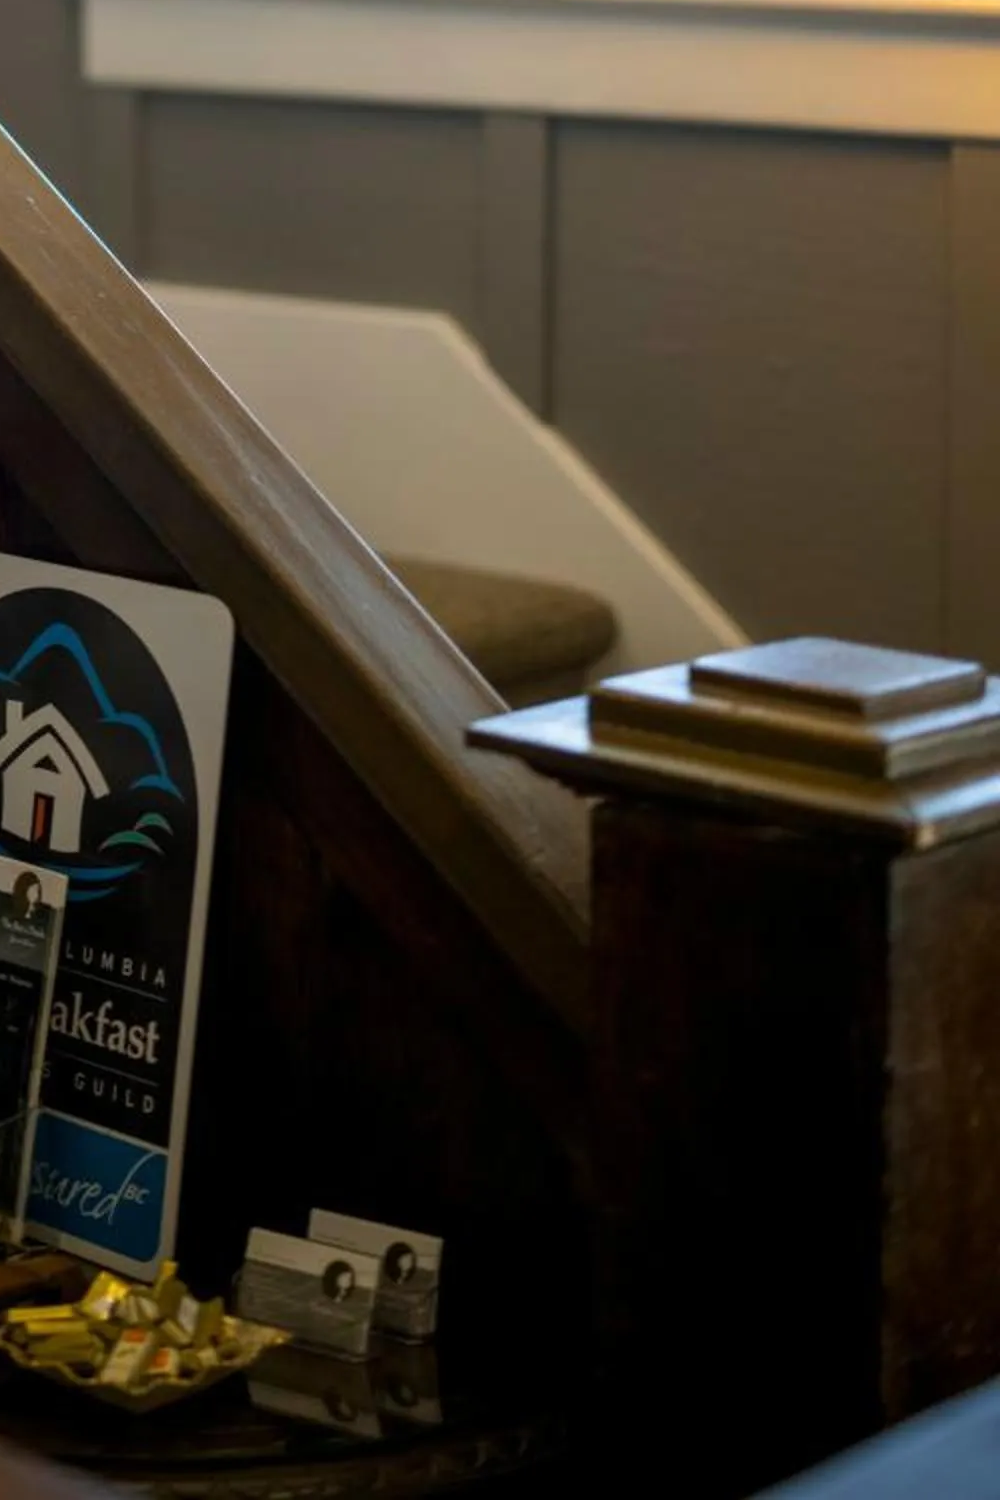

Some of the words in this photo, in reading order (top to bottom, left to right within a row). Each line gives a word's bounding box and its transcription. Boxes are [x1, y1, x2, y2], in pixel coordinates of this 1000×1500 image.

[64, 938, 167, 990] LUMBIA
[50, 990, 161, 1065] akfast
[72, 1071, 156, 1115] GUILD
[123, 1181, 151, 1206] BC
